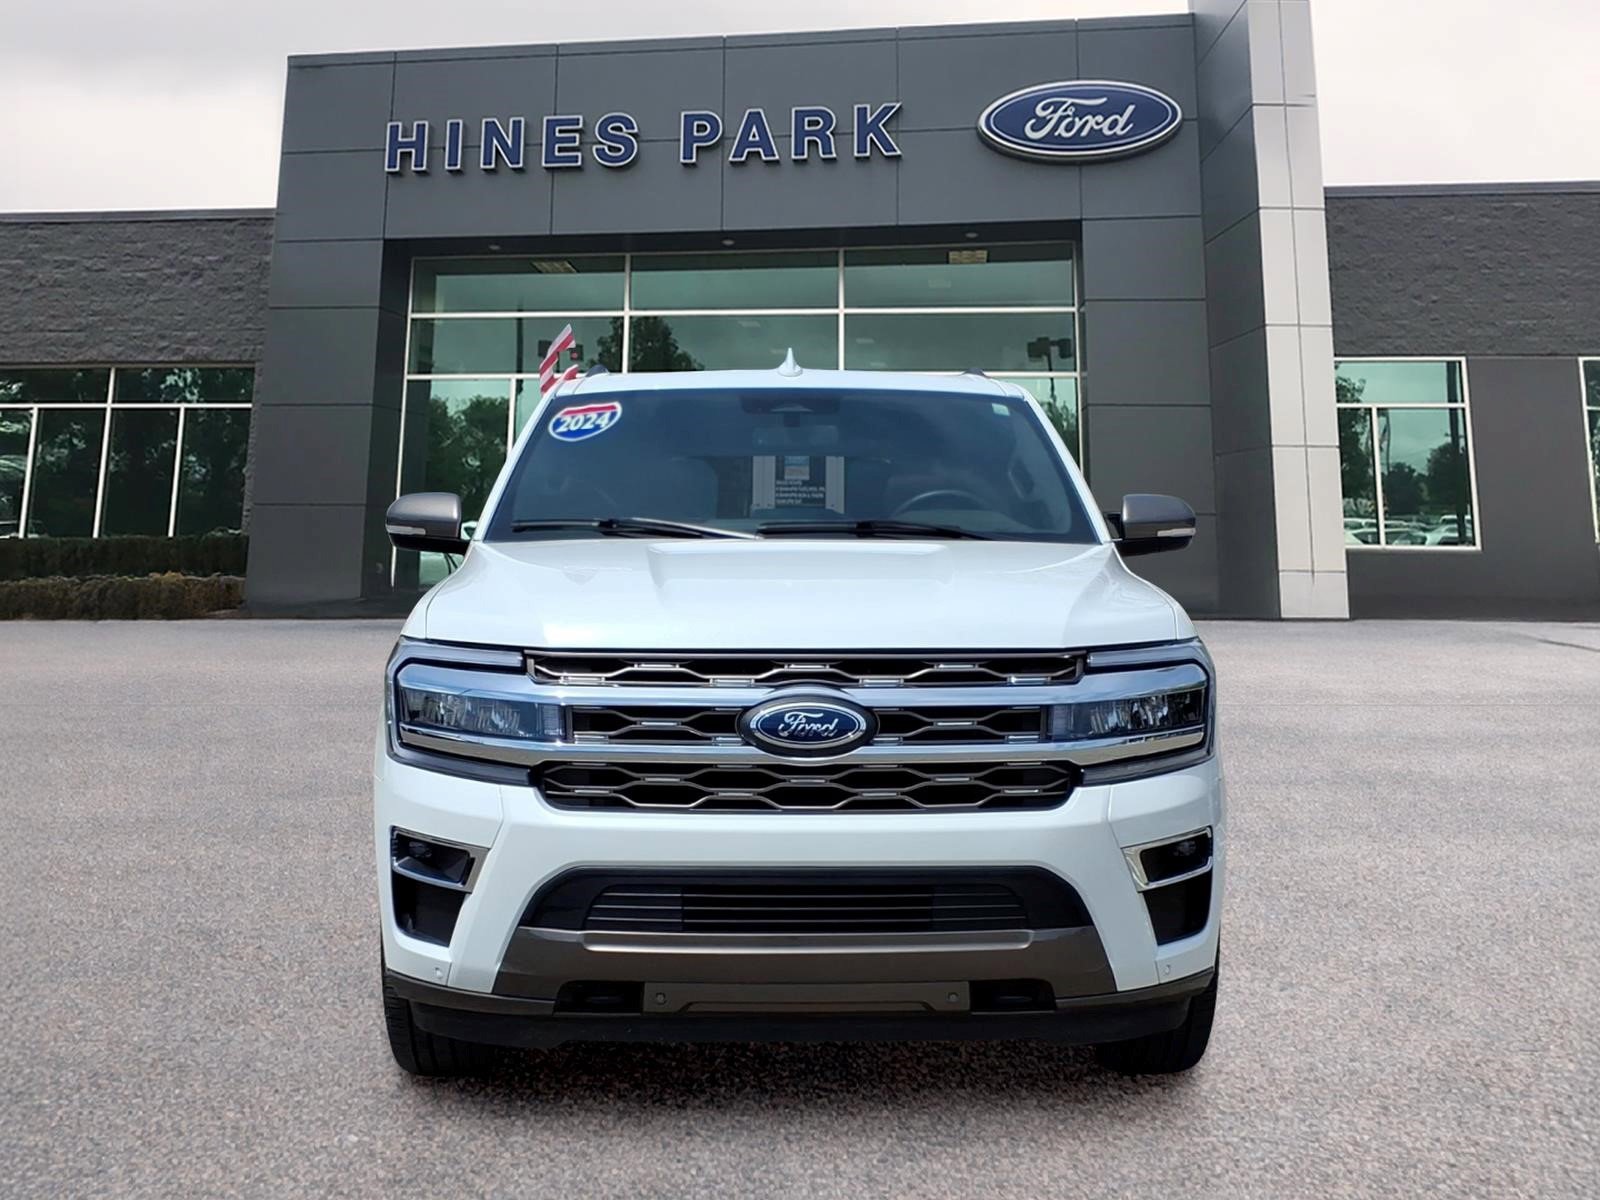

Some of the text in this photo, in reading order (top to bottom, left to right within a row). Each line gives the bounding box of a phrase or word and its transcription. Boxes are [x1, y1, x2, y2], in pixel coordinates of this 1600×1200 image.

[1024, 97, 1136, 139] Ford
[384, 102, 903, 172] HINES PARK
[554, 411, 612, 433] 2024
[778, 711, 839, 737] Ford
